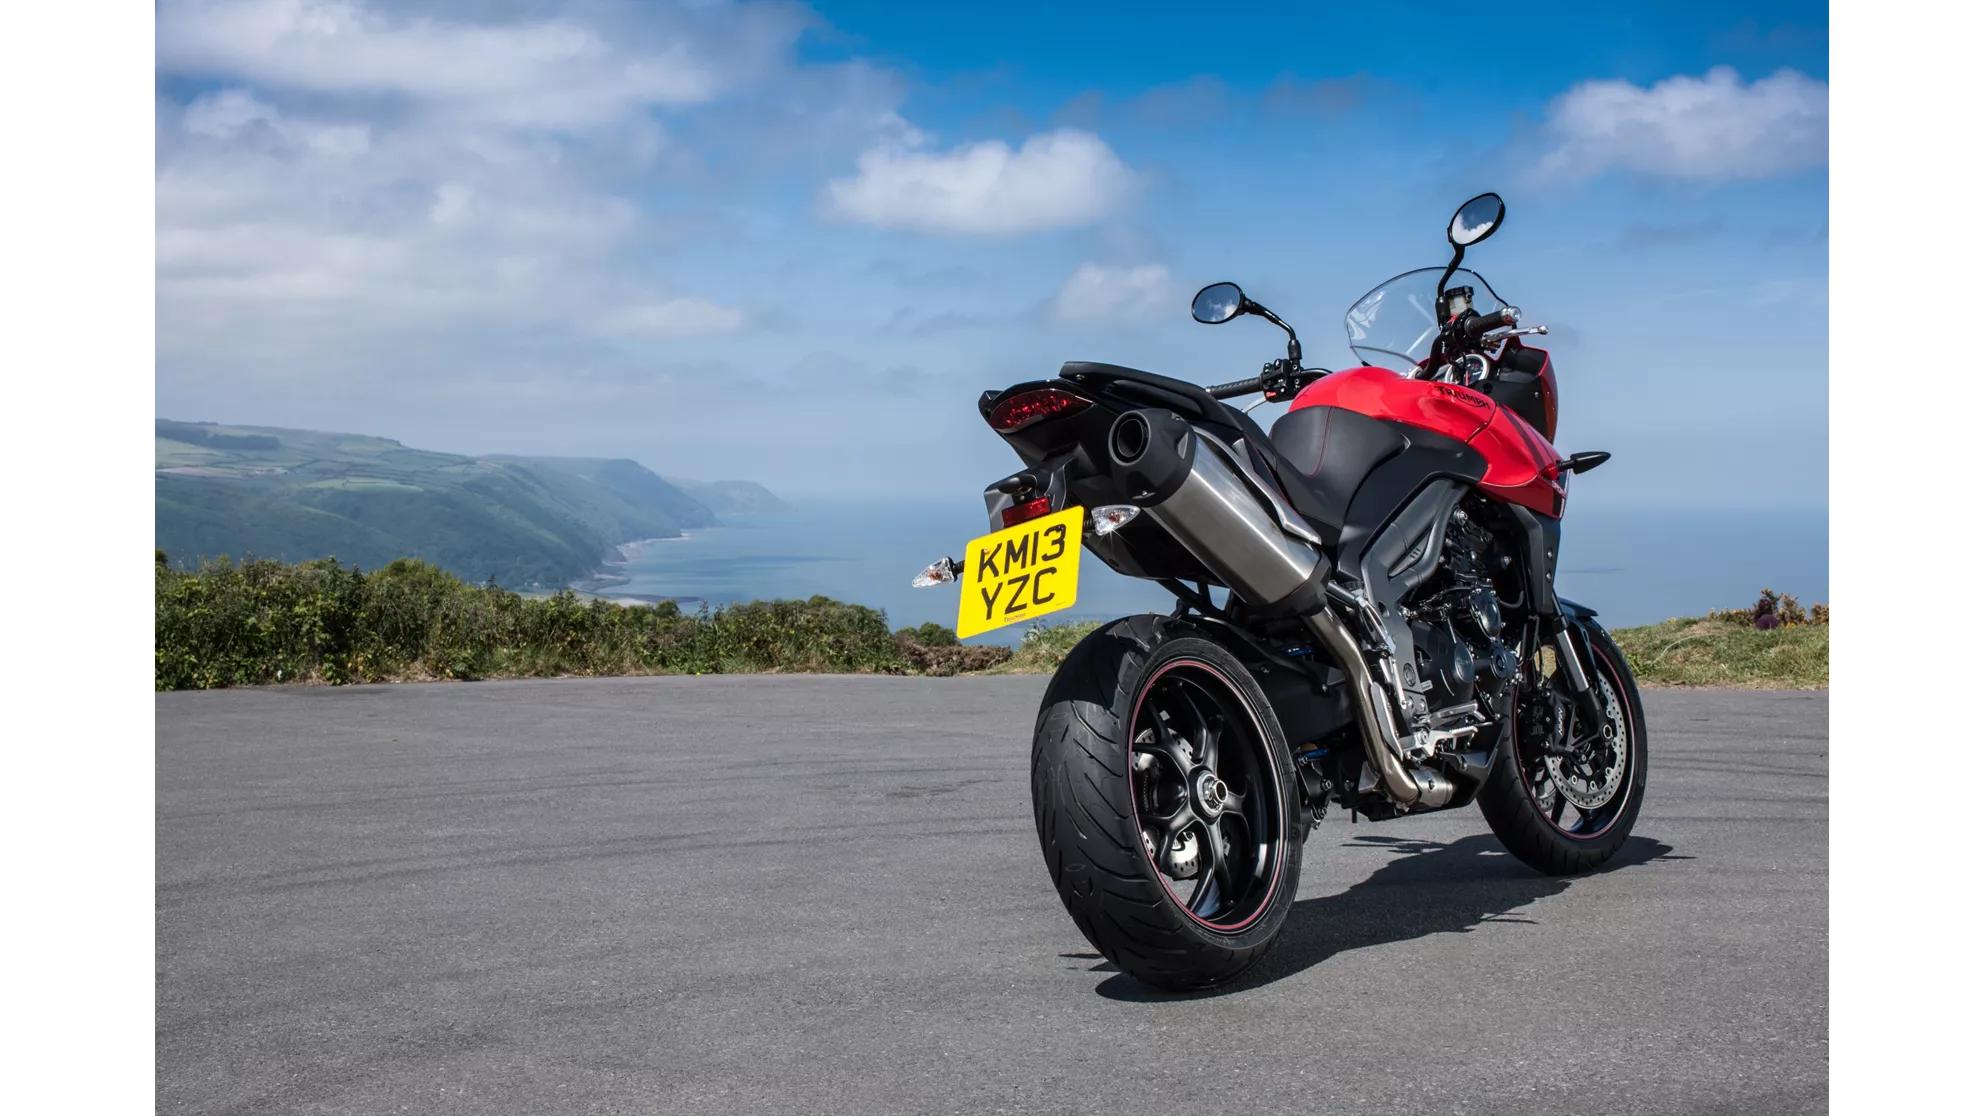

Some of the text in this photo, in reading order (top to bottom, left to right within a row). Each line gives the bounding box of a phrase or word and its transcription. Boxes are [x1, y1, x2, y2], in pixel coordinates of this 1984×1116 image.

[1434, 386, 1491, 410] TRIUMPH
[977, 524, 1067, 583] KM13
[981, 567, 1057, 621] YZC
